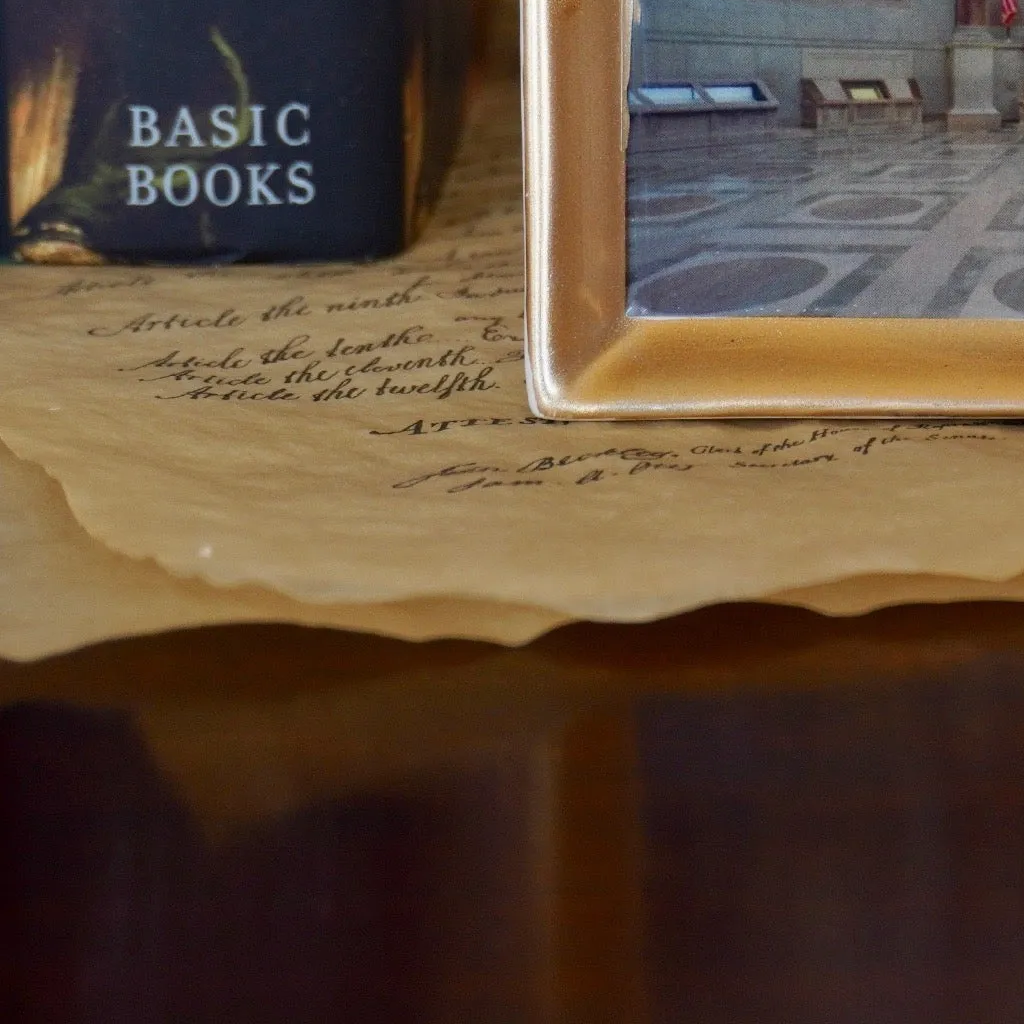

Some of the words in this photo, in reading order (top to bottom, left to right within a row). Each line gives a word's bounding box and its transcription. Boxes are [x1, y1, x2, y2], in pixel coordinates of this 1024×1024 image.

[128, 102, 312, 148] BASIC
[126, 161, 316, 207] BOOKS
[87, 309, 247, 337] Article
[261, 295, 312, 322] the
[327, 276, 430, 313] ninth
[116, 347, 252, 370] Article
[260, 334, 315, 365] the
[138, 369, 272, 386] Article
[284, 360, 338, 384] the
[155, 385, 300, 401] Article
[312, 378, 367, 402] the
